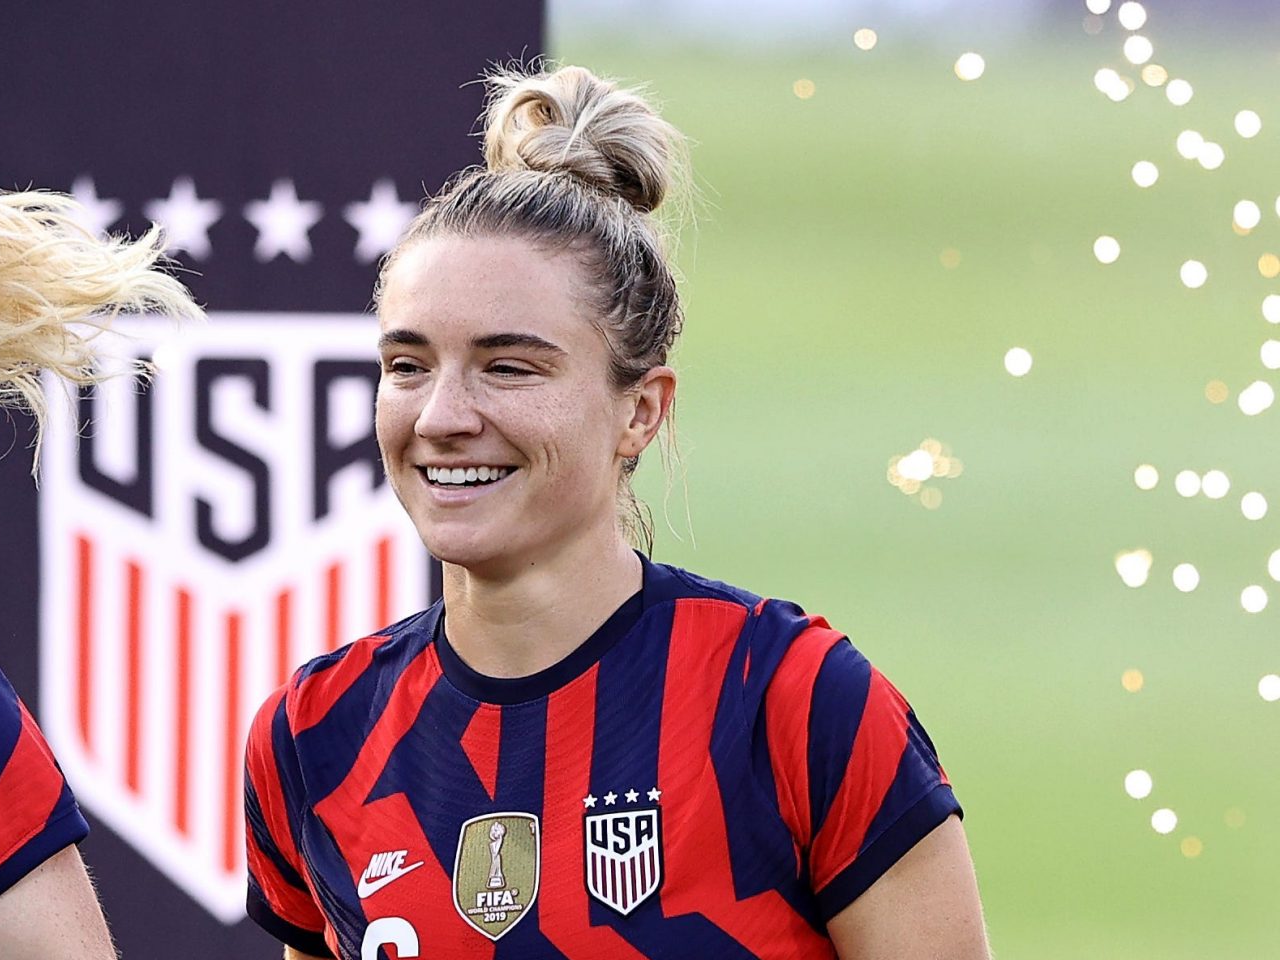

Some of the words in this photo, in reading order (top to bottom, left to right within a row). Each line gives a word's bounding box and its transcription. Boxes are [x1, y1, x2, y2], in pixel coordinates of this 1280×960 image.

[78, 357, 384, 561] USA
[591, 814, 653, 855] USA
[365, 849, 408, 879] NIKE
[467, 906, 488, 914] WORLD
[489, 904, 523, 913] CHAMPIONS
[476, 890, 514, 907] FIFA
[483, 912, 507, 922] 2019
